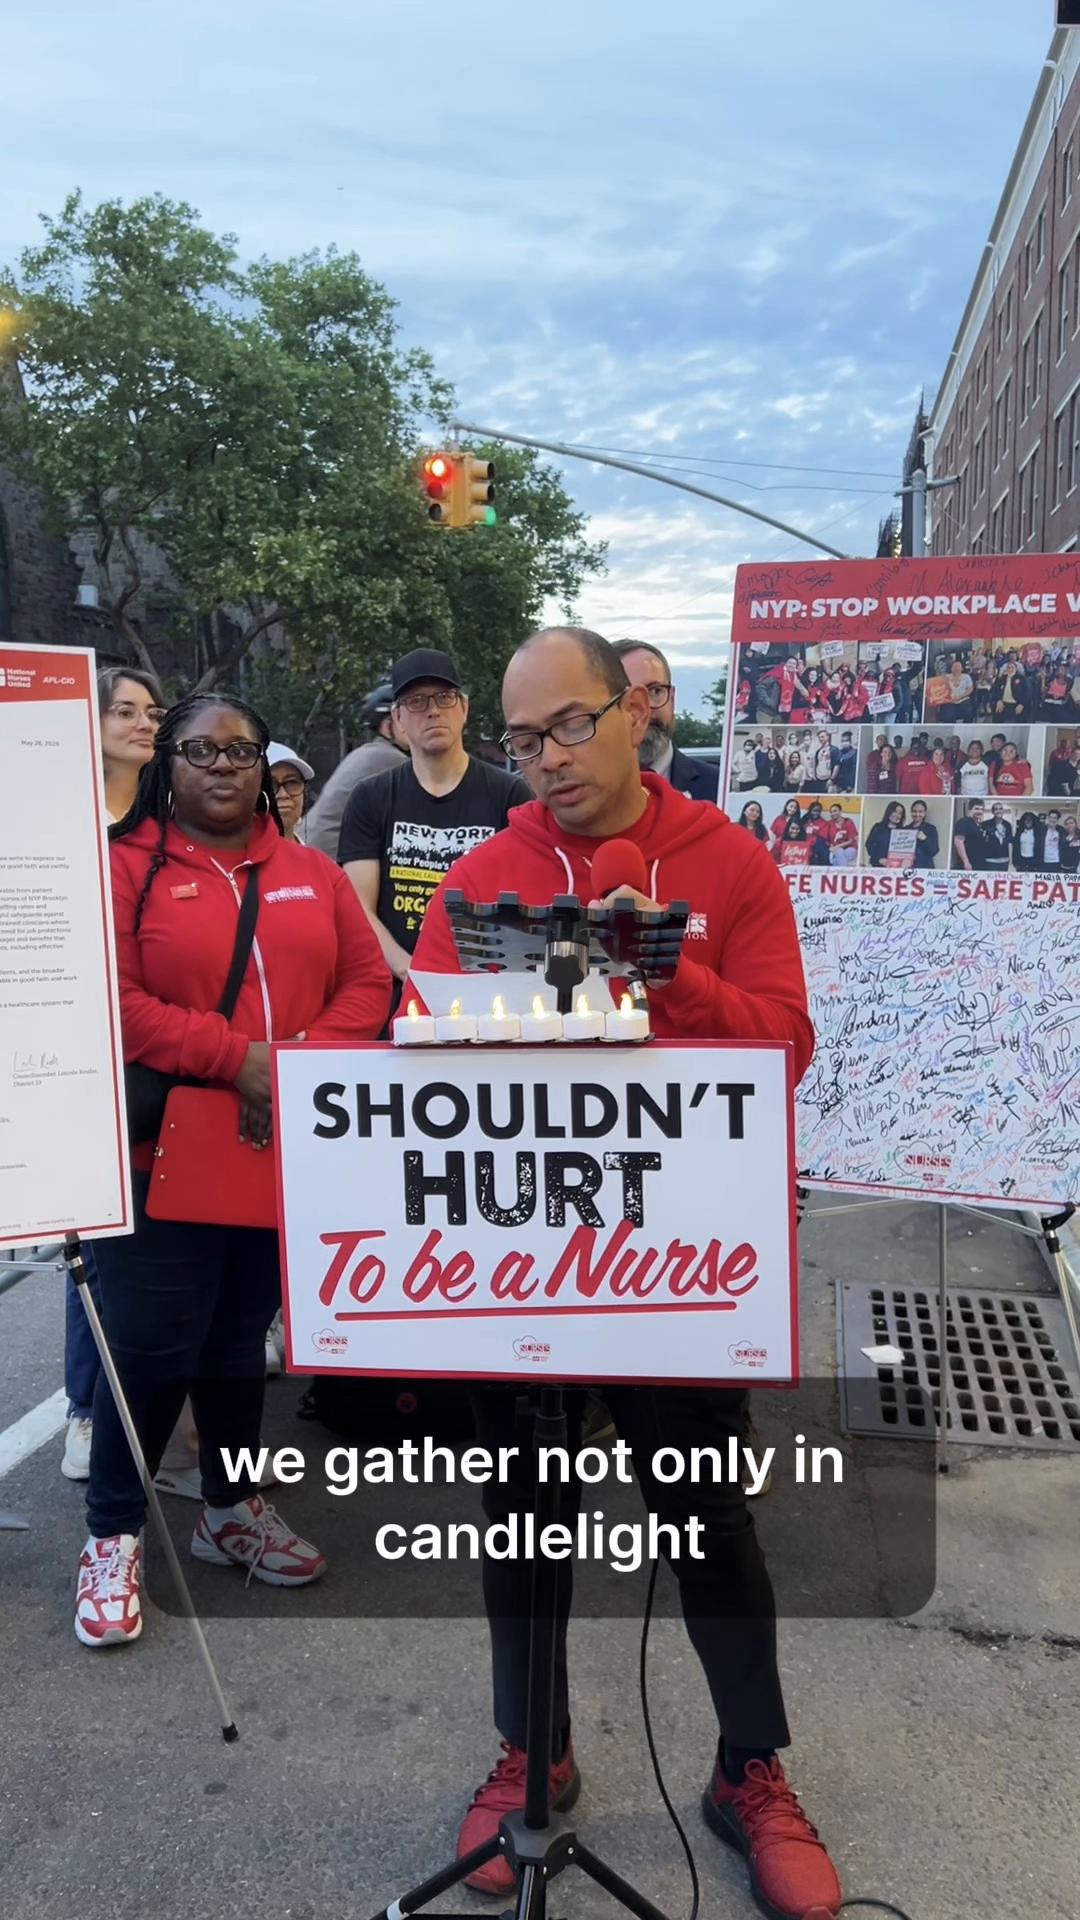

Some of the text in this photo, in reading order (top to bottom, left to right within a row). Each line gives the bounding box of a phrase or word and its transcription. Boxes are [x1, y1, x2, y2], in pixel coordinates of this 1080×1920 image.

[750, 599, 808, 619] NYP:
[811, 597, 879, 618] STOP
[886, 593, 1057, 616] WORKPLACE
[7, 668, 36, 676] National
[7, 674, 31, 682] Nurses
[43, 676, 76, 685] AFL-CIO
[395, 823, 494, 841] NEW YORK
[391, 854, 449, 871] Poor People's
[394, 882, 407, 892] You
[408, 884, 425, 896] only
[785, 874, 812, 894] FE
[820, 874, 925, 897] NURSES
[957, 879, 1023, 901] SAFE
[393, 895, 425, 914] ORG
[312, 1081, 755, 1140] SHOULDN'T
[904, 1153, 952, 1170] NURSES
[403, 1150, 662, 1229] HURT
[317, 1218, 759, 1307] To be a Nurse
